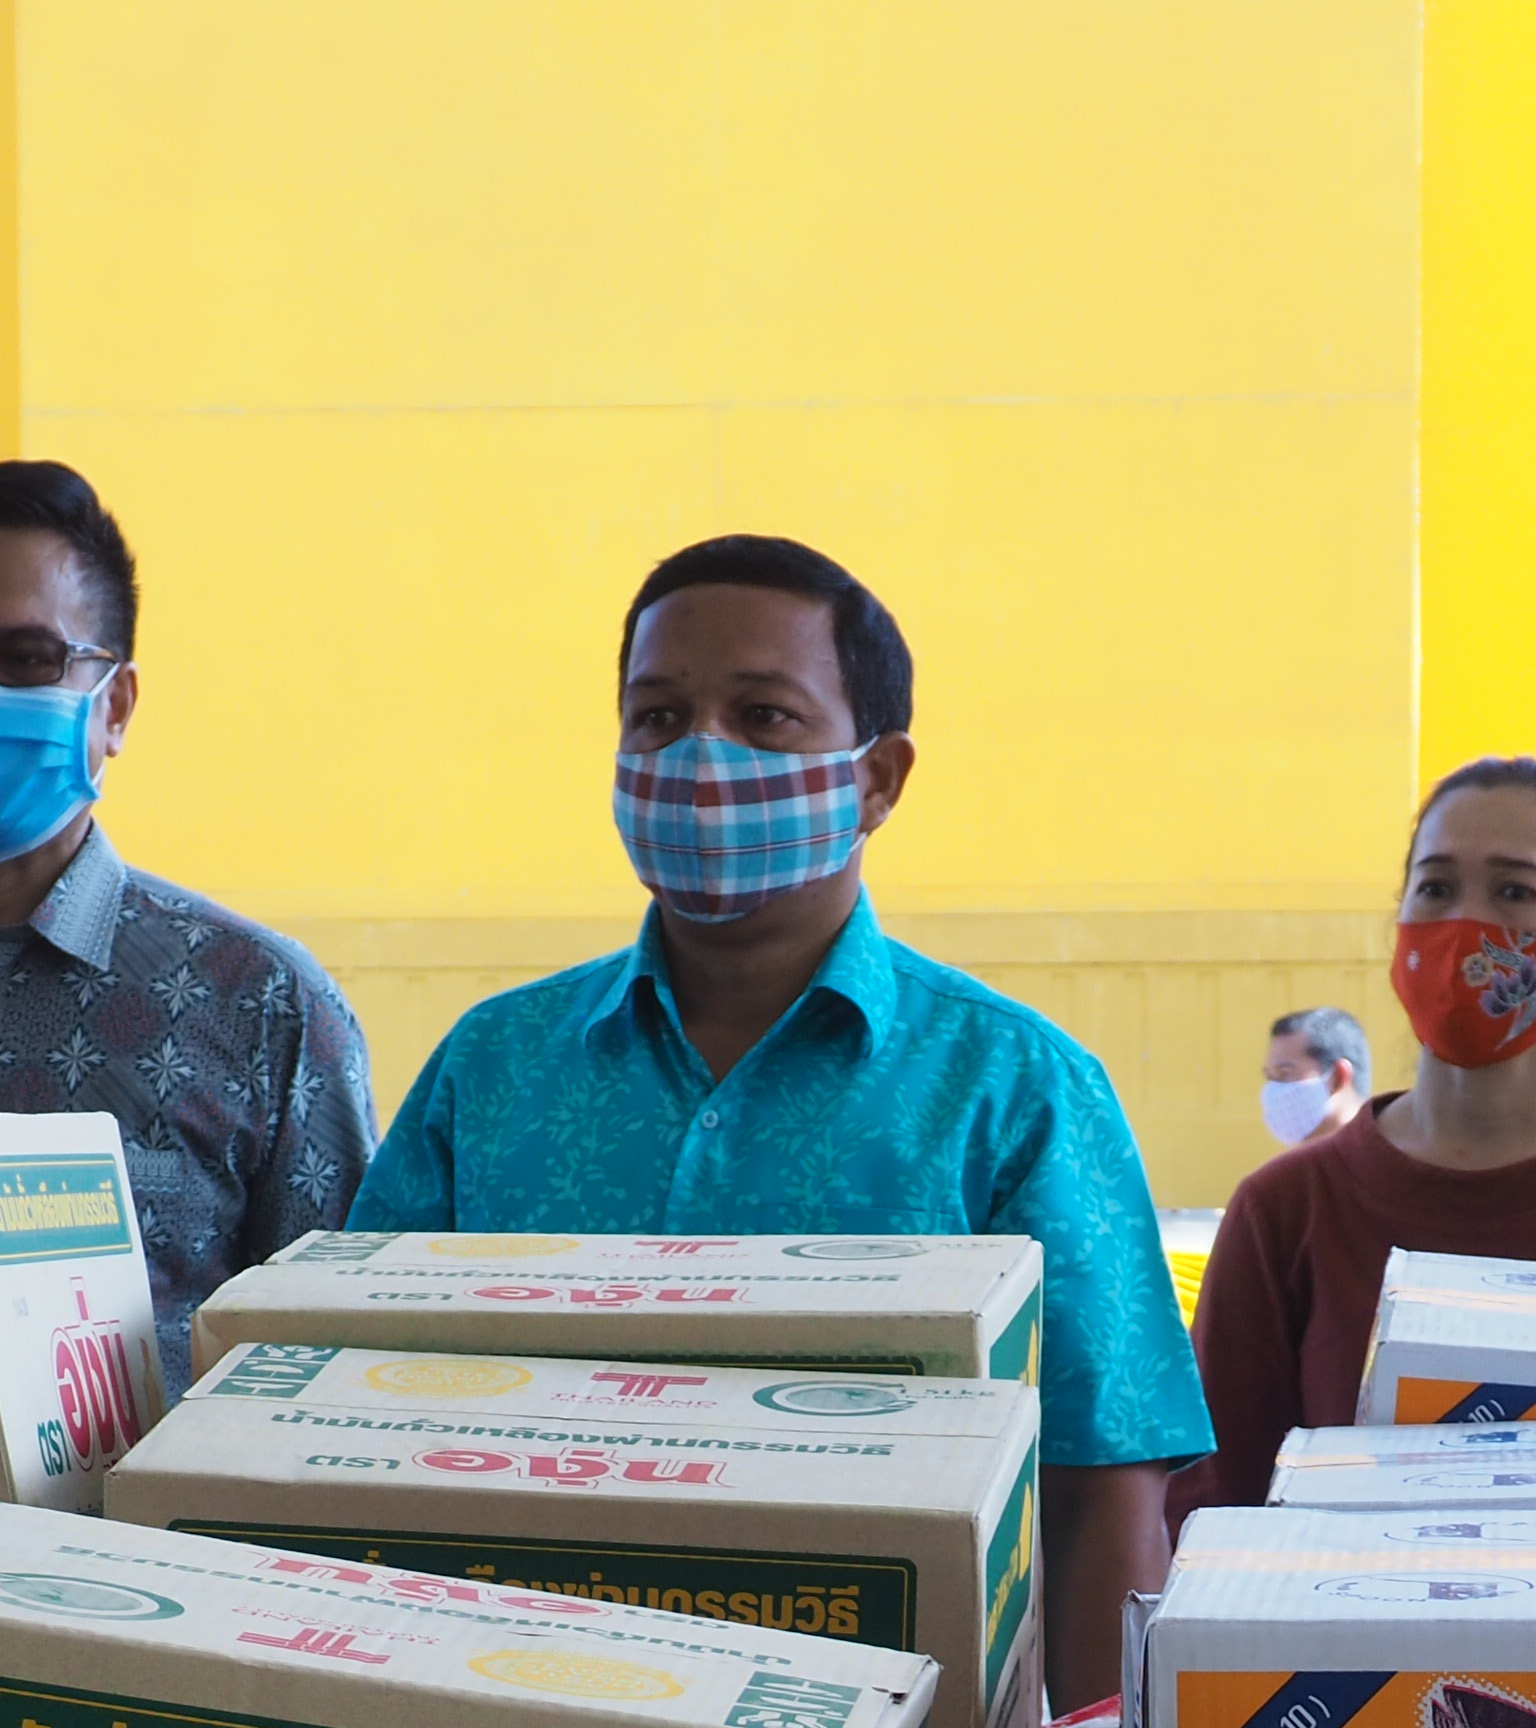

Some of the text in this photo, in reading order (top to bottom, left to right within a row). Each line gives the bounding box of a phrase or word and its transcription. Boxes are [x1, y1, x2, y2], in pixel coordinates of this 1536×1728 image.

[466, 1281, 756, 1309] องุ่น
[36, 1276, 147, 1478] ตรา อง่น
[271, 1410, 896, 1455] น้ำมันถั่วเหลืองผ่านกรรมวิธี
[305, 1446, 737, 1488] ตรา องุ่น
[248, 1548, 612, 1618] องุ่น
